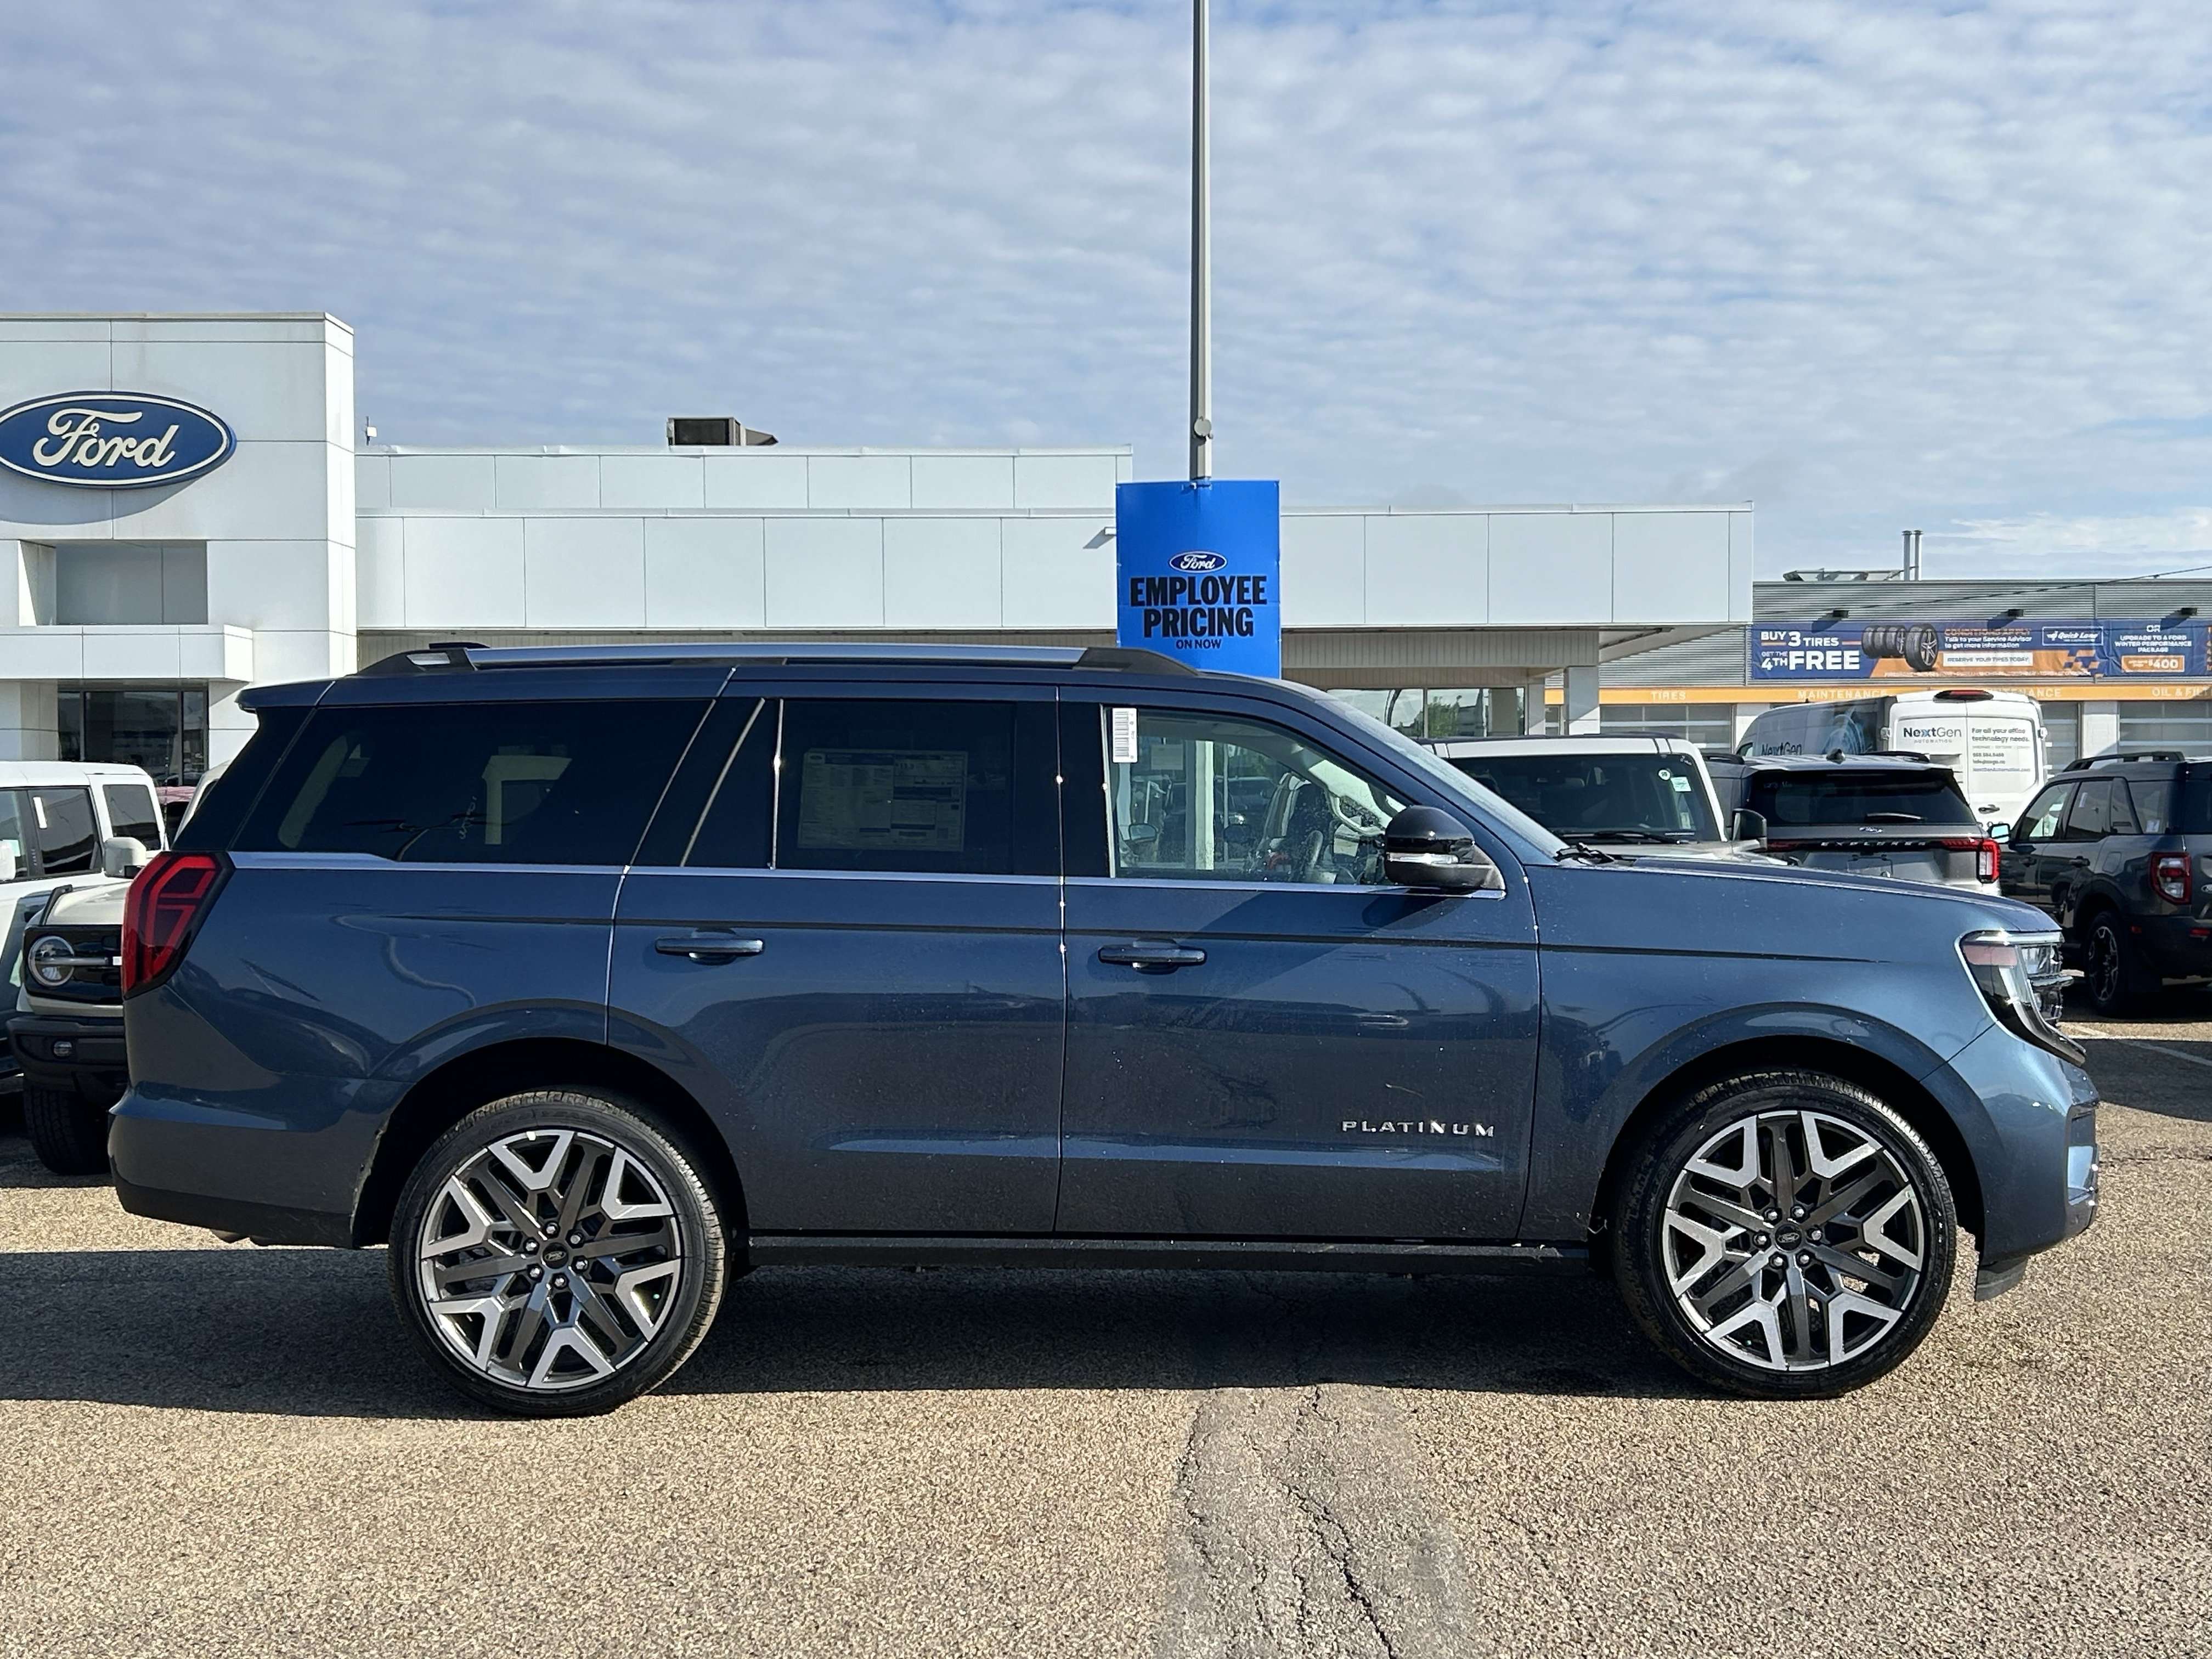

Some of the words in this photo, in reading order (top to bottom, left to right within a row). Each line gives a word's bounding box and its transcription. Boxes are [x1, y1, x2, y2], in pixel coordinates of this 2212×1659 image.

[33, 408, 179, 467] Ford
[1180, 554, 1216, 569] Ford
[1130, 575, 1267, 606] EMPLOYEE
[1143, 607, 1254, 638] PRICING
[2146, 624, 2160, 633] OR
[1176, 640, 1192, 650] ON
[1194, 639, 1221, 649] NOW
[1760, 631, 1786, 641] BUY
[1787, 631, 1801, 647] 3
[1803, 637, 1839, 647] TIRES
[1761, 657, 1788, 671] 4TH
[1788, 650, 1860, 670] FREE
[2148, 659, 2179, 669] $400
[1651, 690, 1686, 700] TIRES
[1797, 689, 1888, 699] MAINTENANCE
[2152, 687, 2172, 697] OIL
[2175, 688, 2183, 696] &
[1903, 727, 1962, 738] NextGen
[1760, 741, 1802, 755] NextGen
[1341, 1120, 1494, 1137] PLATINUM
